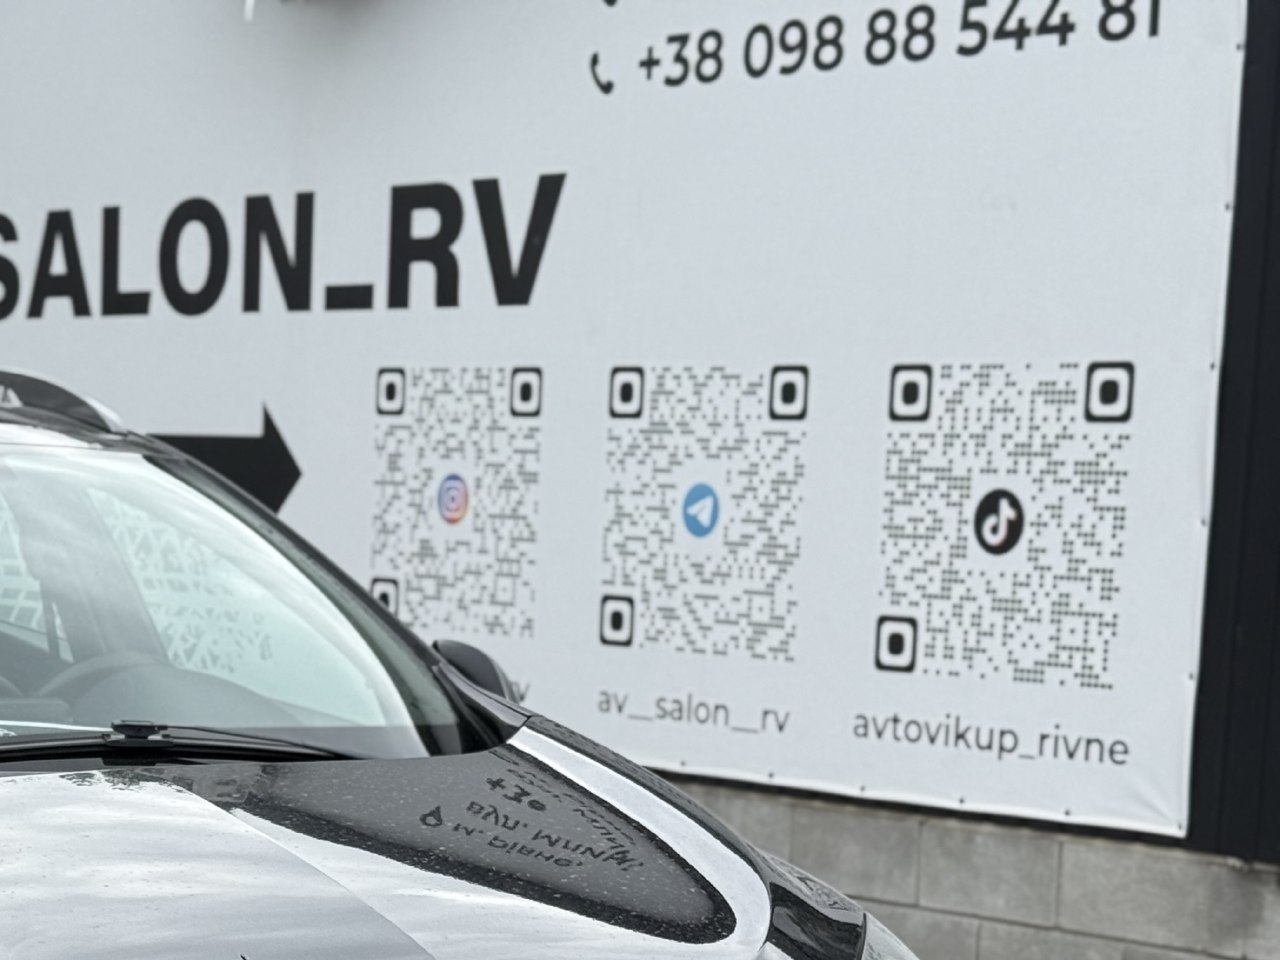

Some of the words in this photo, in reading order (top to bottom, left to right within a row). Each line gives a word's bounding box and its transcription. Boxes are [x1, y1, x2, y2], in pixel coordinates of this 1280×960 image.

[638, 31, 724, 87] +38
[743, 15, 845, 79] 098
[865, 8, 937, 65] 88
[957, 0, 1077, 56] 544
[1098, 0, 1162, 42] 81
[852, 712, 1130, 766] avtovikup_rivne
